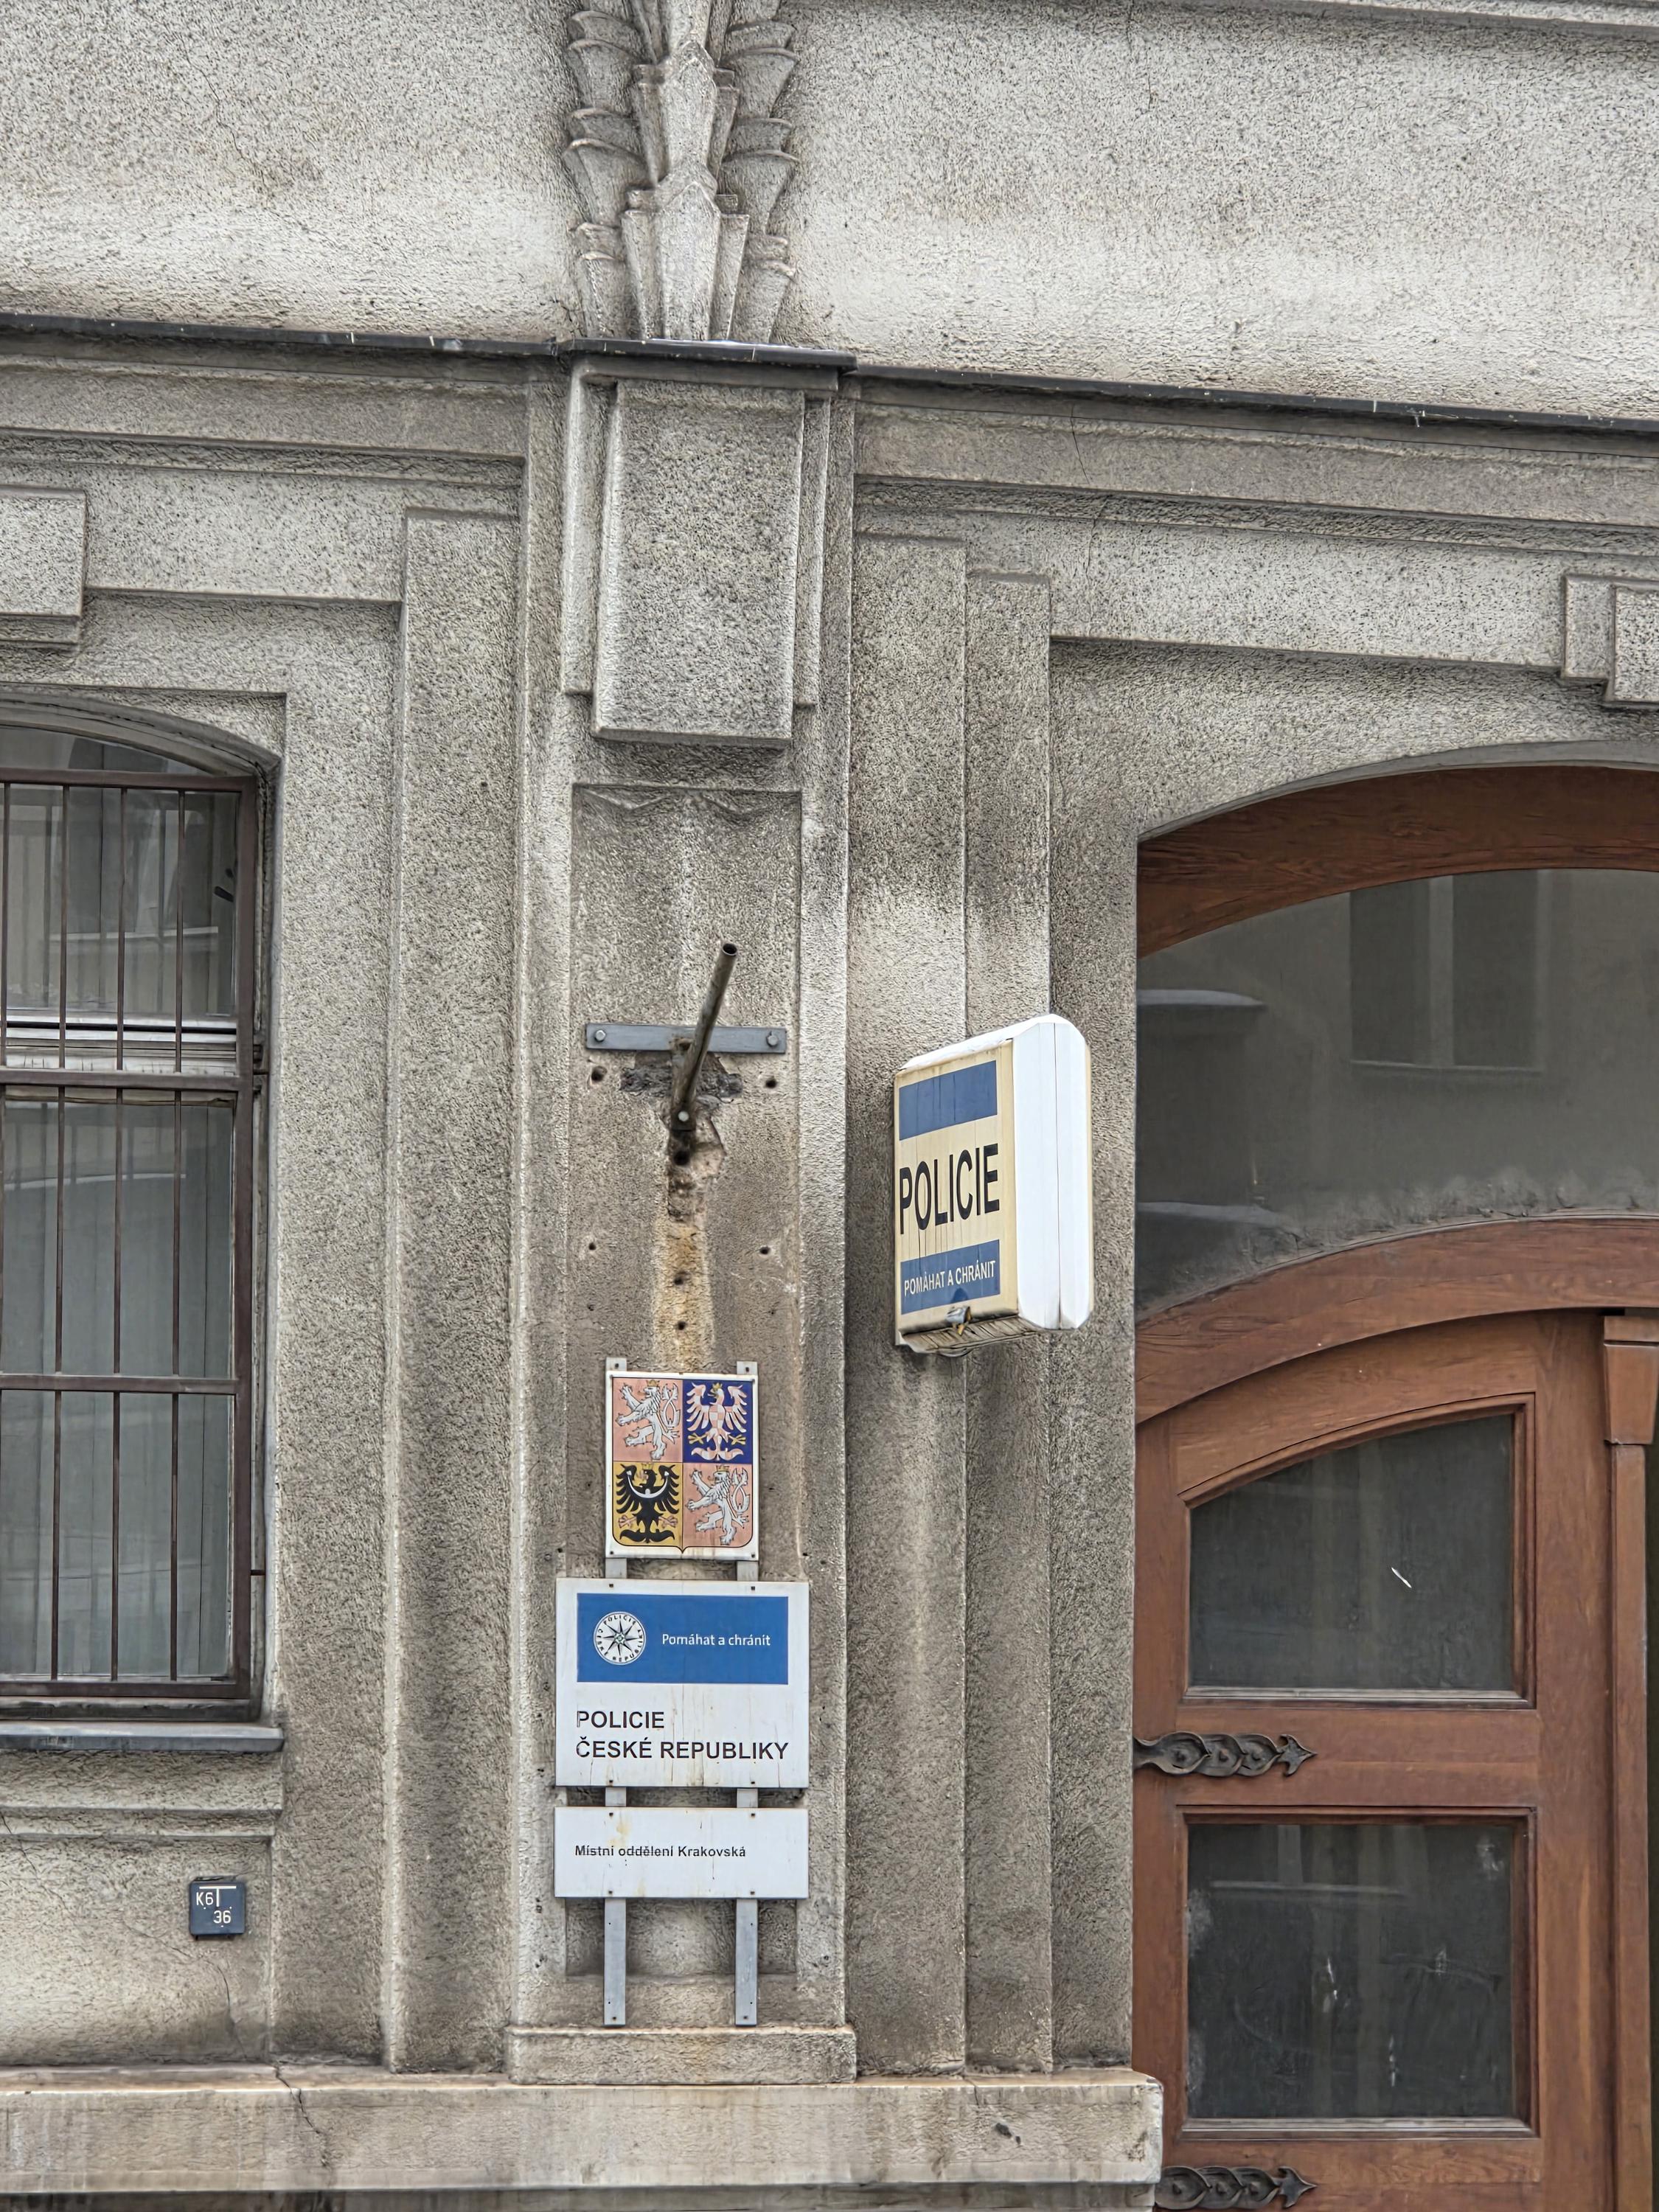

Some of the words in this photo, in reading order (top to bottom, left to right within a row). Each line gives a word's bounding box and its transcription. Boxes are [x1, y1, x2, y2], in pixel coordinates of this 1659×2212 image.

[900, 1144, 1000, 1234] POLICIE
[904, 1272, 945, 1297] POMÁHAT
[947, 1270, 954, 1286] A
[955, 1259, 996, 1284] CHRÁNIT
[662, 1634, 715, 1646] Pomáhat
[718, 1636, 726, 1646] a
[728, 1634, 771, 1646] chránit
[577, 1711, 664, 1728] POLICIE
[576, 1736, 652, 1758] ČESKÉ
[661, 1742, 788, 1760] REPUBLIKY
[575, 1845, 614, 1856] Místní
[618, 1846, 673, 1857] oddělení
[678, 1846, 745, 1857] Krakovská
